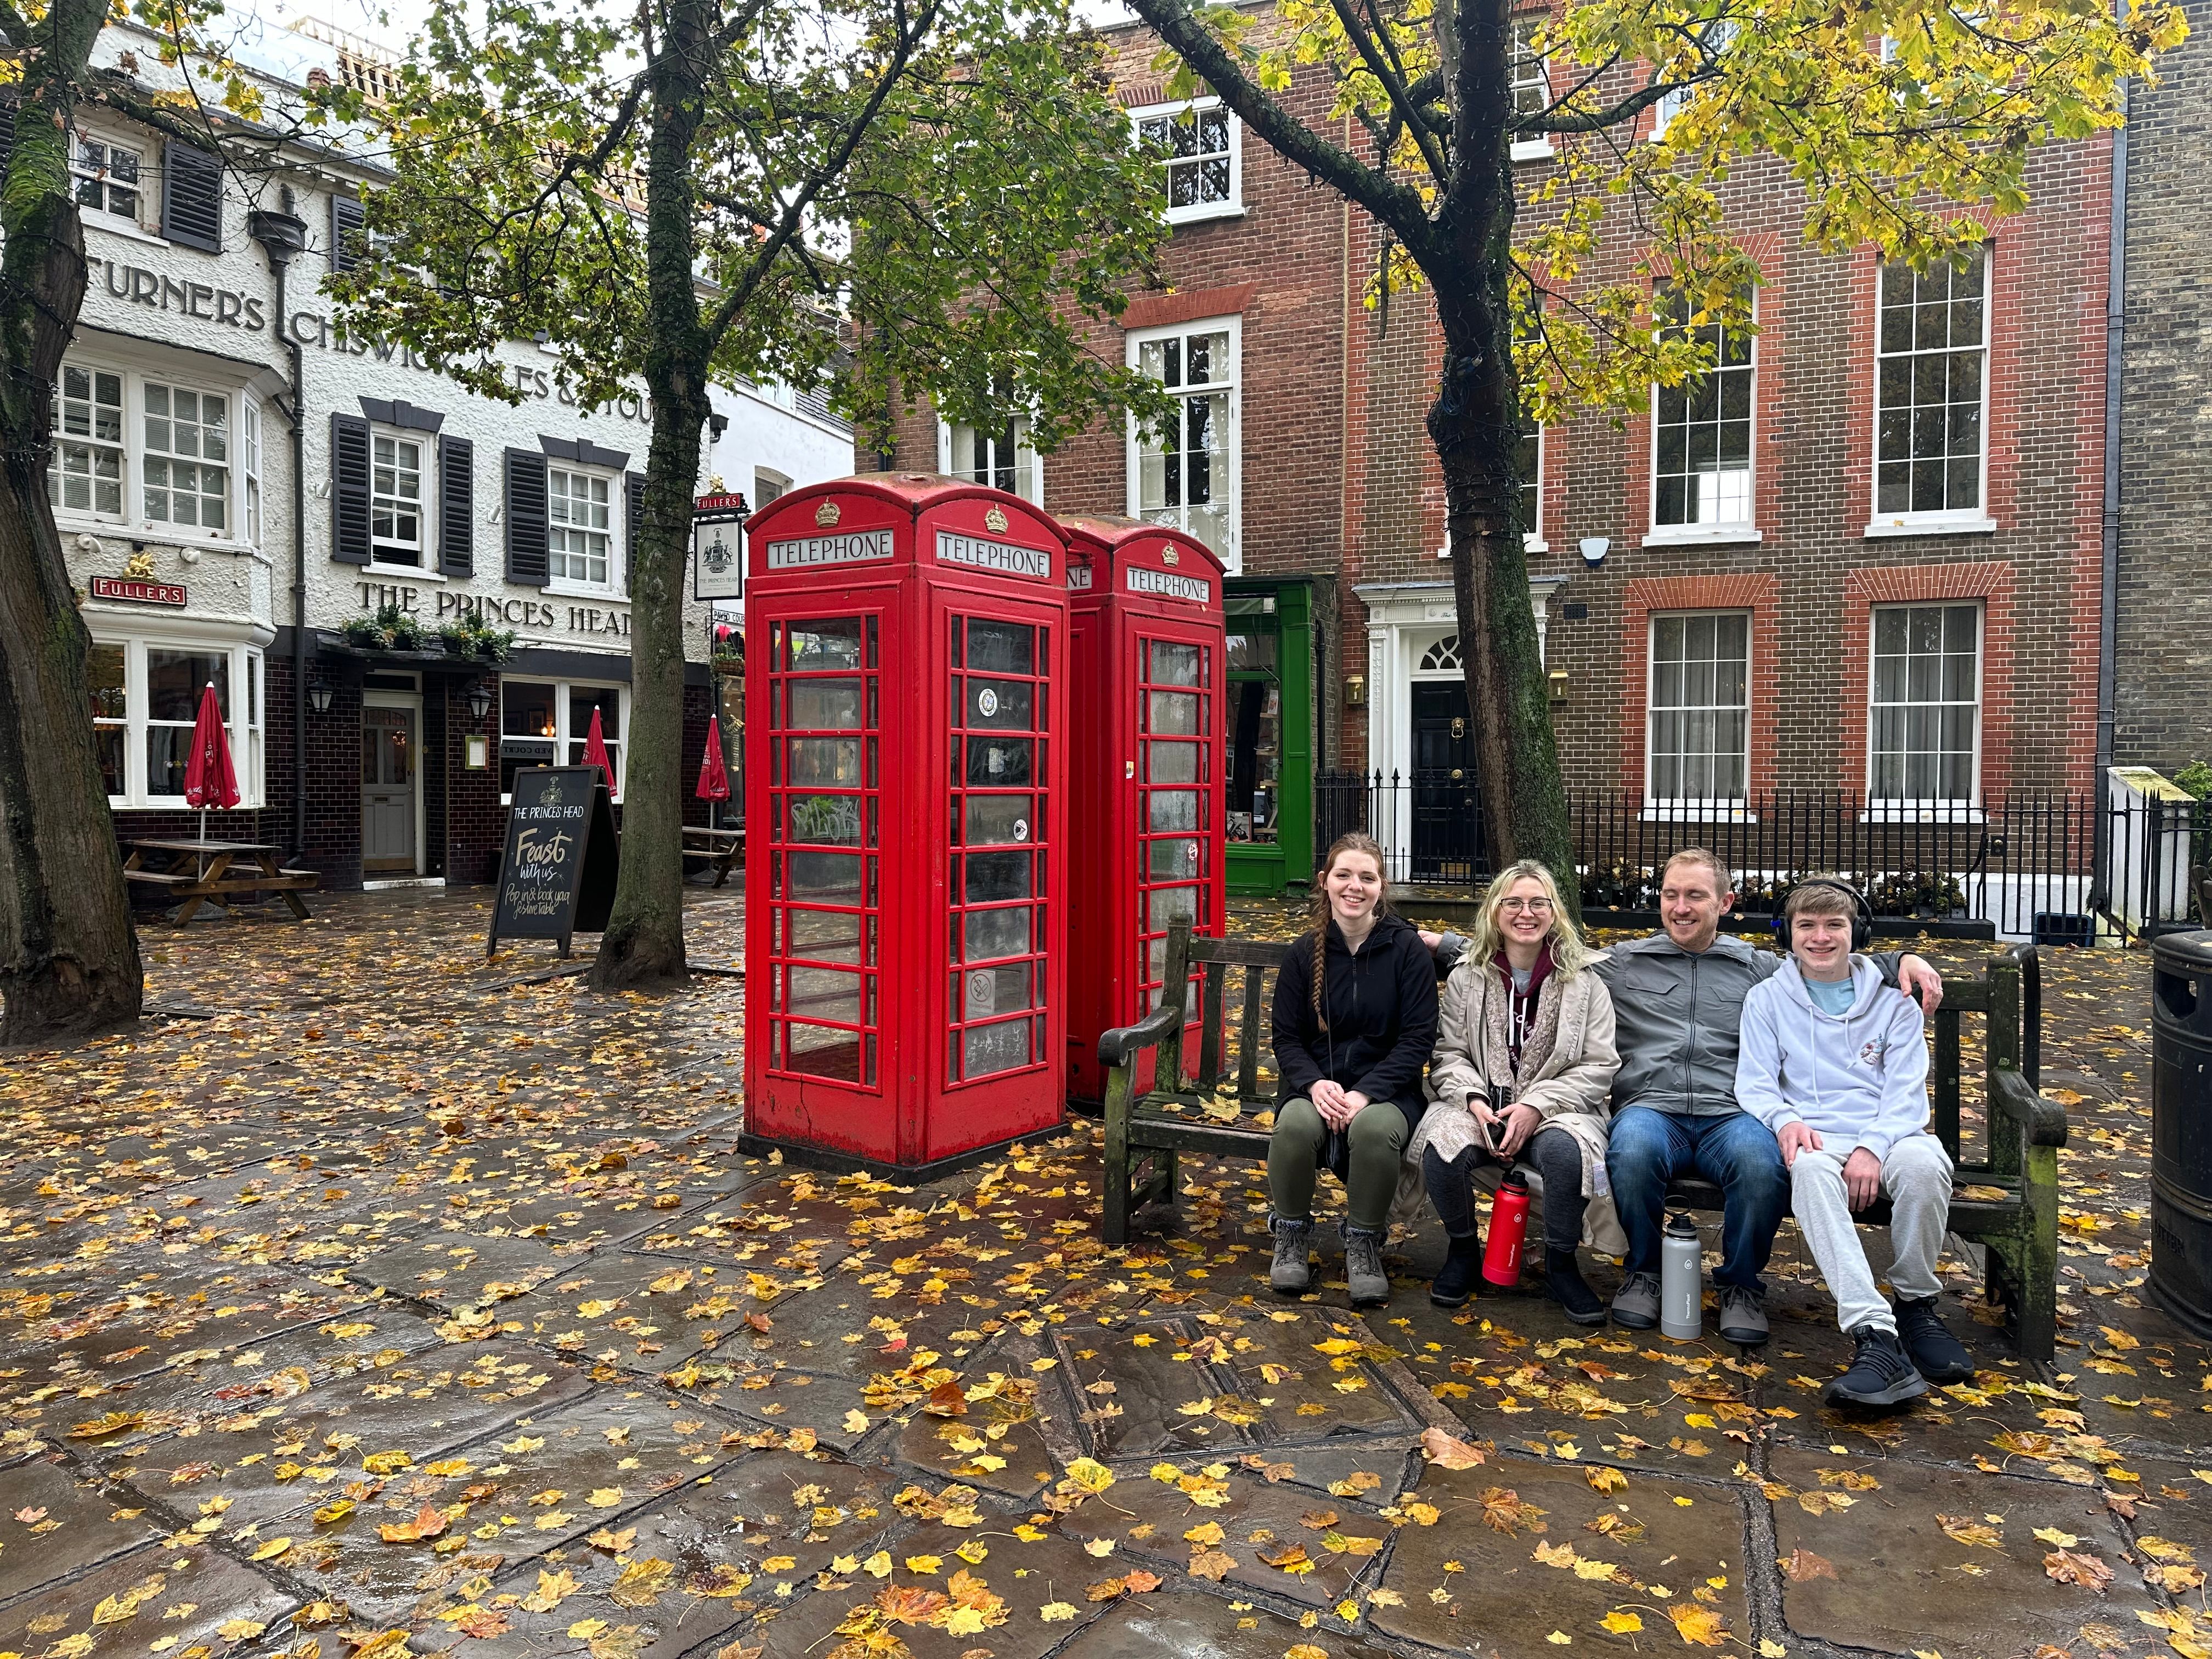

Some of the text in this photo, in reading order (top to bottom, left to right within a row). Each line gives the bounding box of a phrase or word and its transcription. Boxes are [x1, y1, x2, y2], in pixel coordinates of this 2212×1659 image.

[697, 496, 737, 509] FULLER'S
[772, 533, 890, 565] TELEPHONE
[940, 535, 1046, 575] TELEPHONE
[99, 579, 180, 602] FULLER'S
[1129, 569, 1206, 599] TELEPHONE
[356, 581, 421, 612] THE
[436, 591, 554, 627] PRINCES
[515, 808, 528, 819] THE
[563, 806, 584, 817] HEAD
[516, 828, 573, 866] Feast
[541, 866, 557, 881] us
[505, 883, 520, 906] Pop
[521, 889, 530, 904] in
[529, 887, 536, 901] &
[538, 887, 554, 903] book
